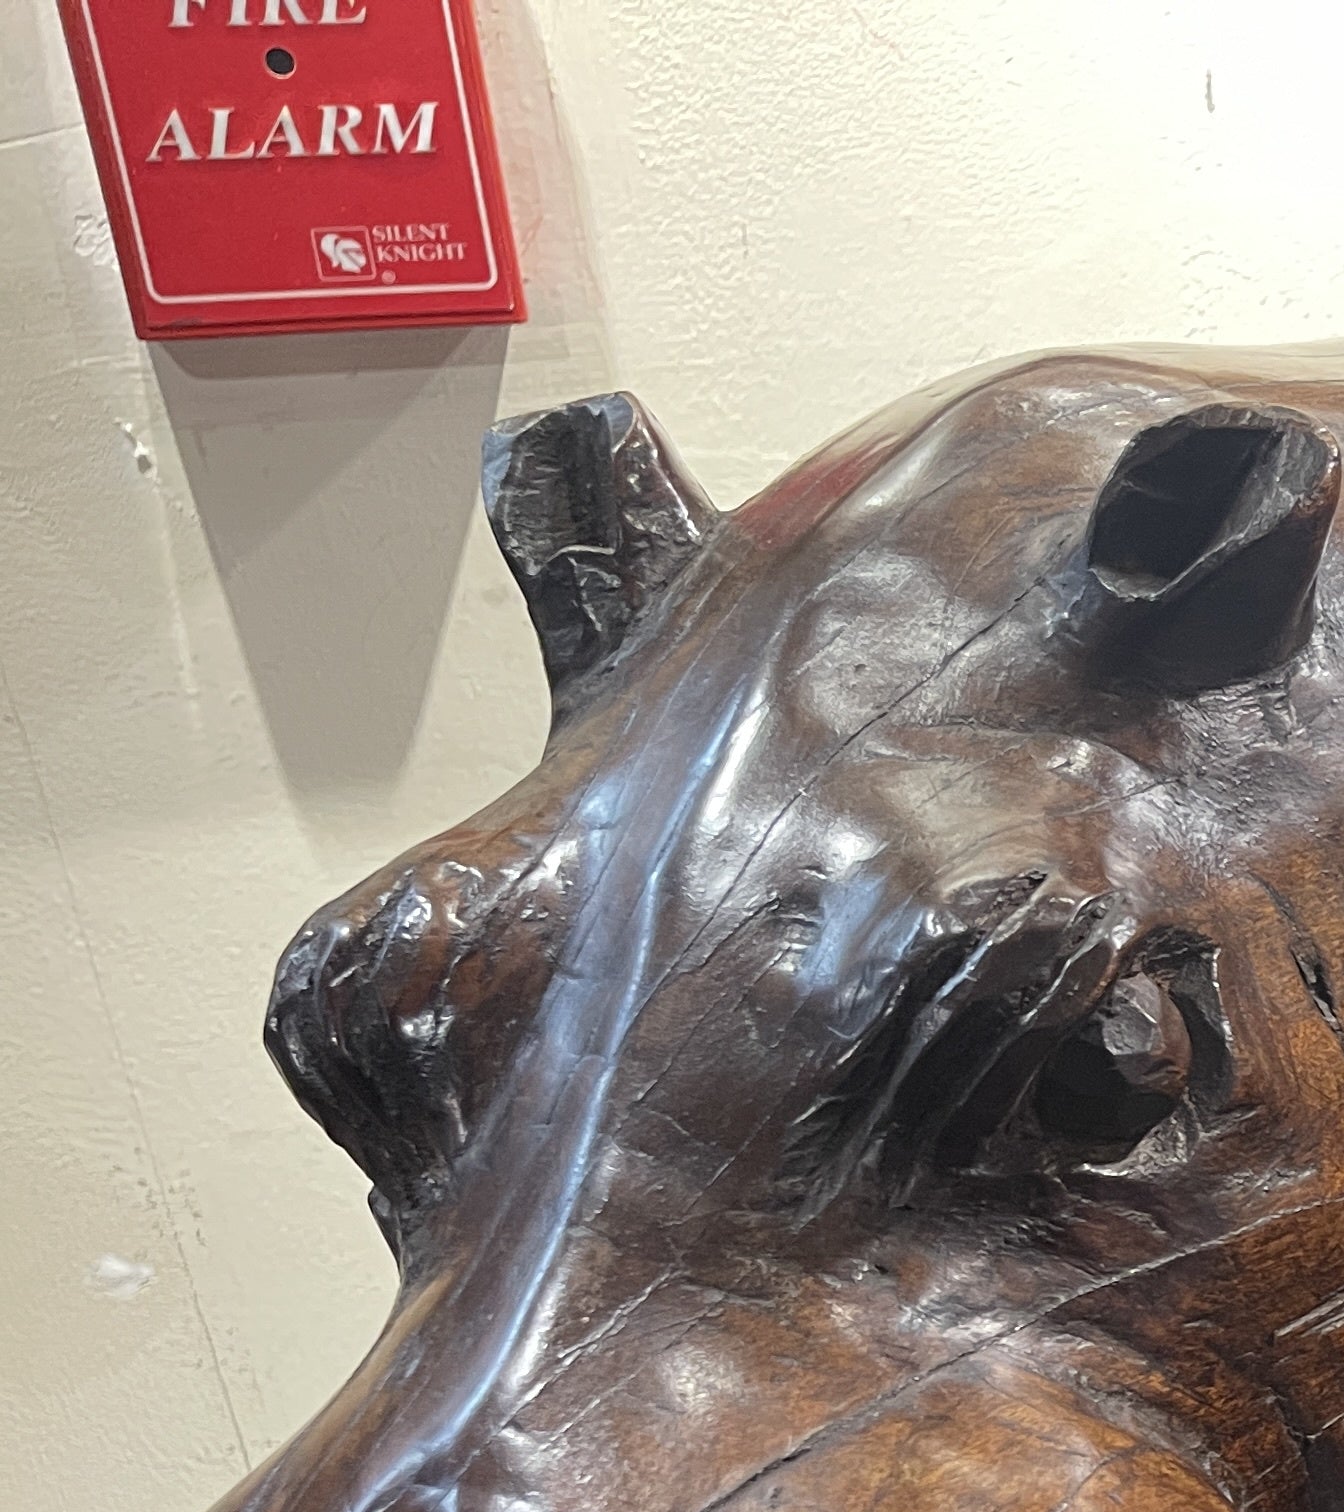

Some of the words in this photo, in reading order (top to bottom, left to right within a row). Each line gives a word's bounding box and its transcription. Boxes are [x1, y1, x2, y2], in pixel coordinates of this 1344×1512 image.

[145, 102, 439, 162] ALARM
[372, 222, 448, 242] SILENT
[376, 242, 467, 262] KNIGHT
